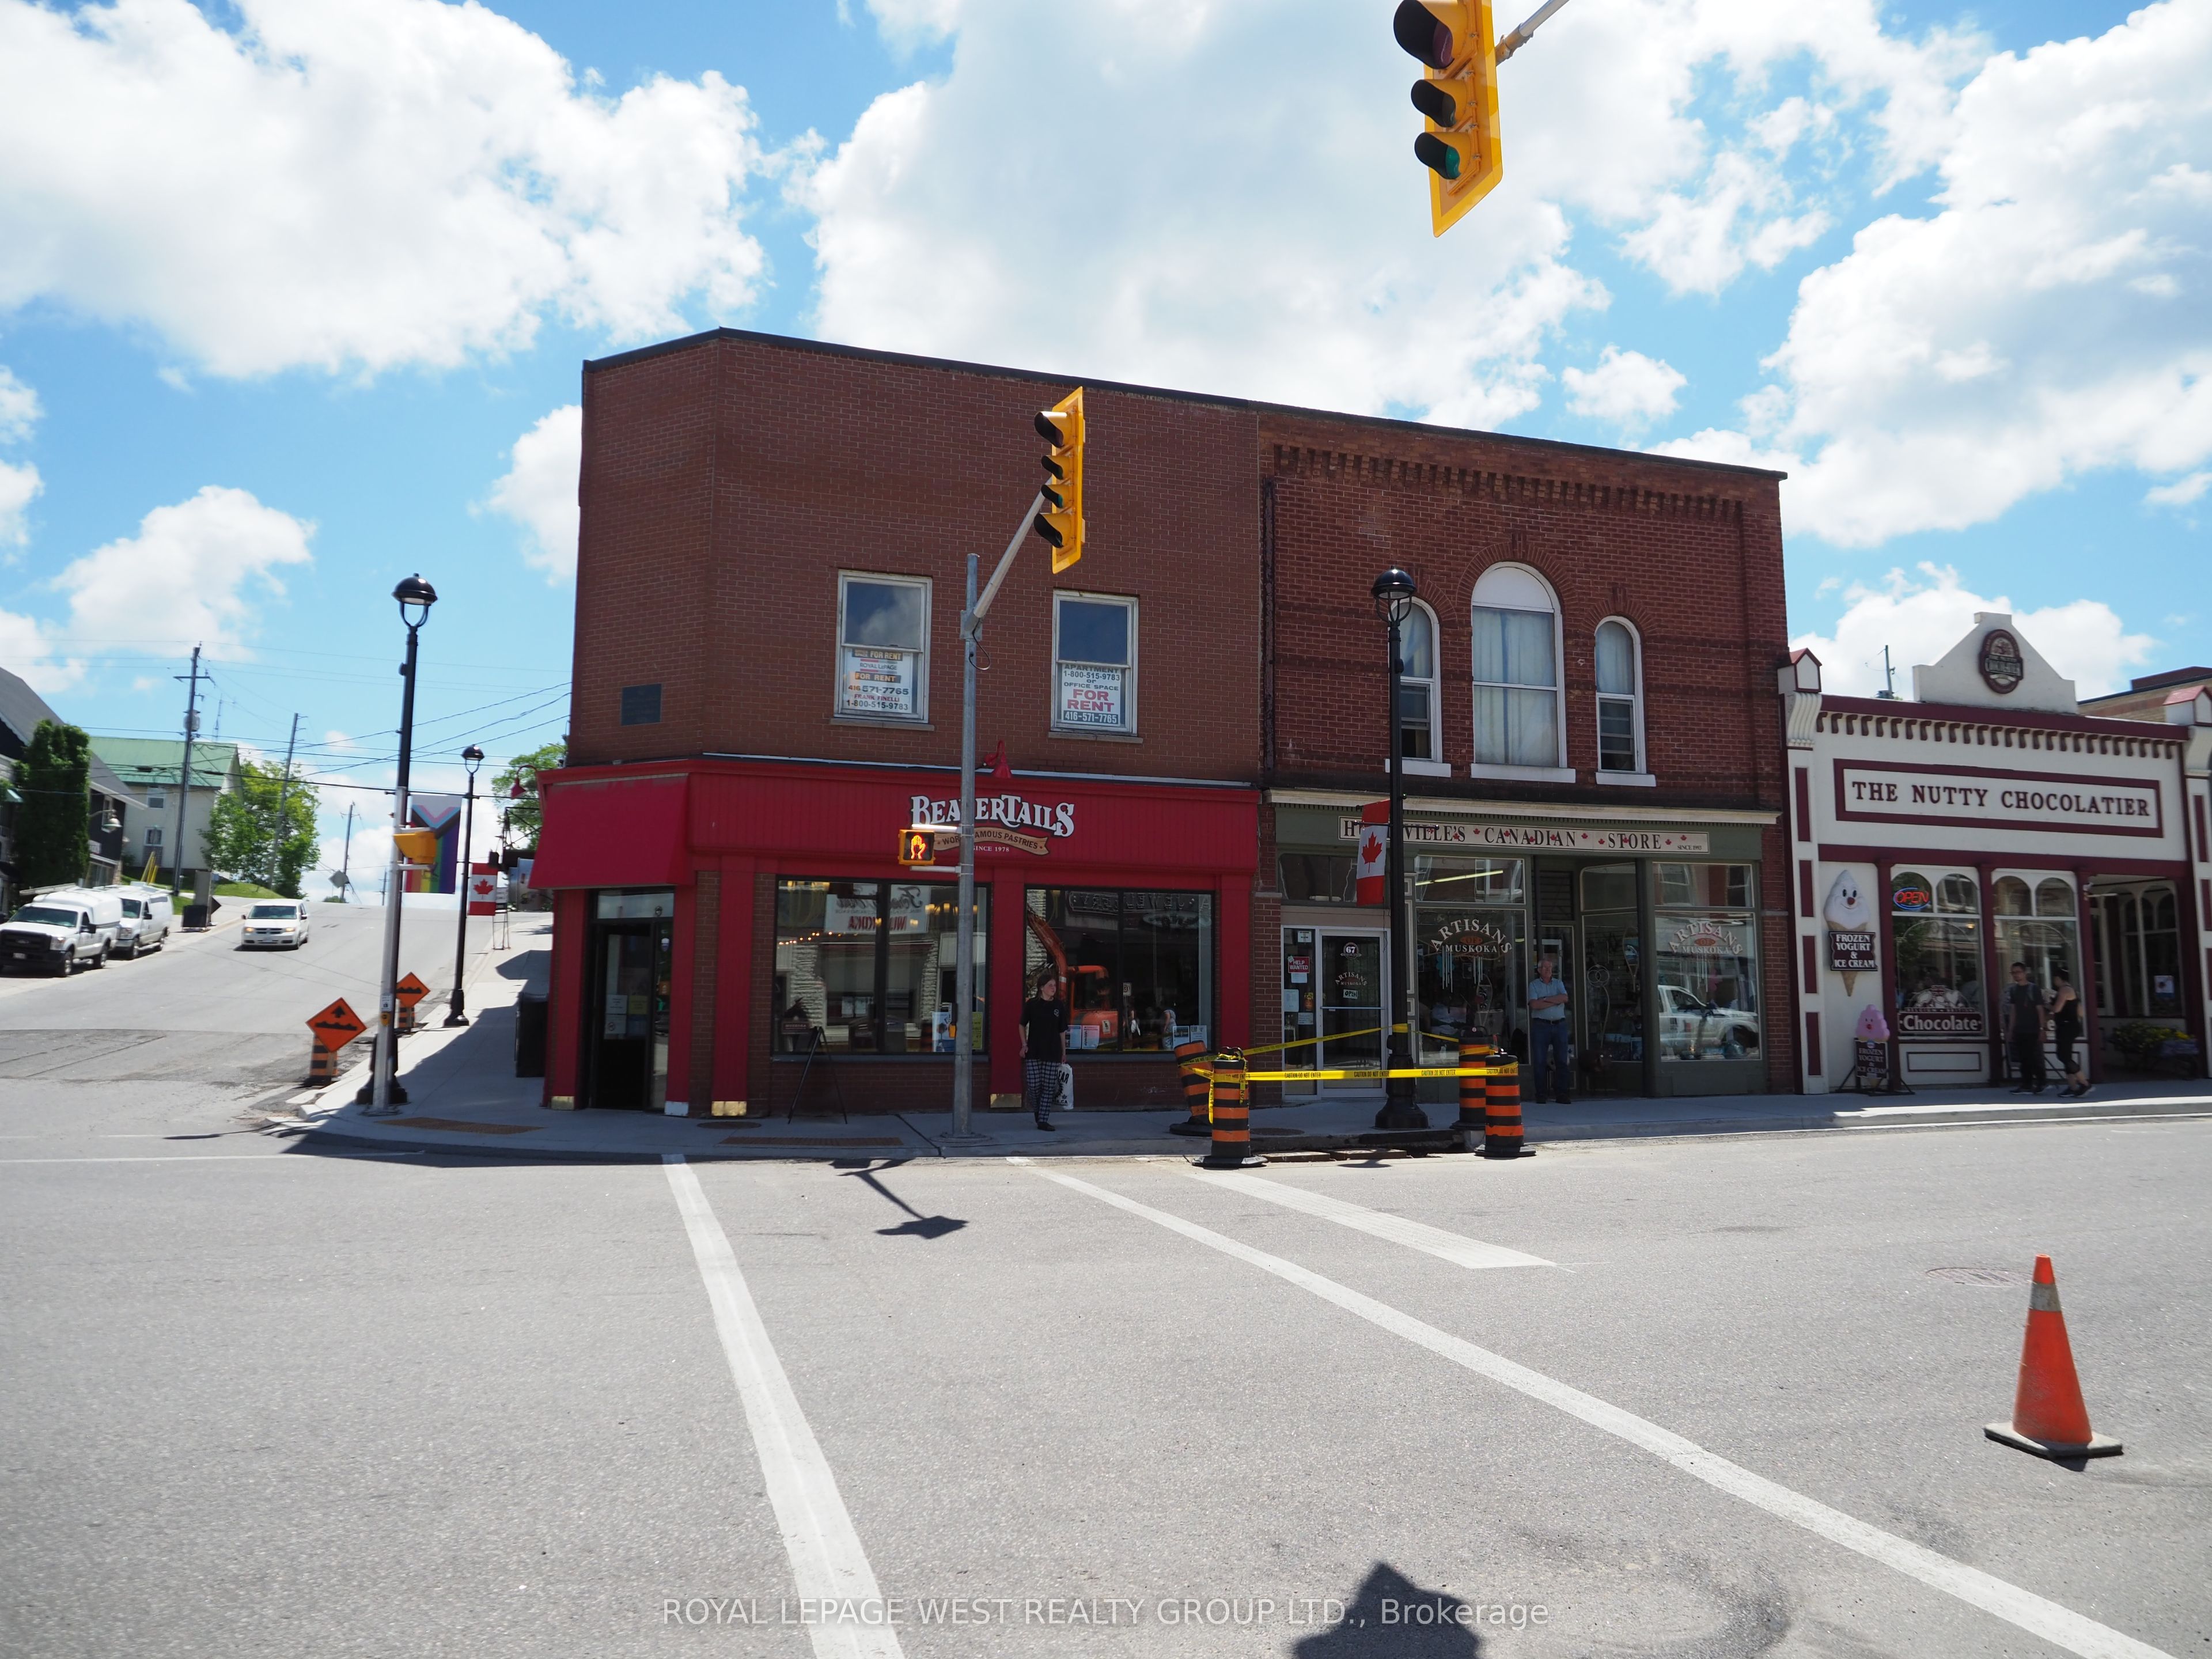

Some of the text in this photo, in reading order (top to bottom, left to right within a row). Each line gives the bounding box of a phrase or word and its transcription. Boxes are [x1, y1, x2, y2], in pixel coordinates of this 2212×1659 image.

[885, 652, 902, 660] RENT
[1064, 664, 1119, 673] APARTMENT
[1063, 671, 1120, 681] 1-800-515-9783
[862, 685, 909, 695] 571-7765
[1073, 688, 1109, 701] FOR
[846, 699, 908, 710] 1-800-515-9783
[1067, 699, 1115, 712] RENT
[1065, 711, 1117, 724] 416-571-7765
[1852, 781, 2150, 816] THE NUTTY CHOCOLATIER
[911, 794, 1075, 837] BEAERTAILS
[942, 831, 1038, 849] WOR AMOUS PASTRIES
[1343, 820, 1661, 849] HVILLE'S CANADIAN STORE
[1895, 891, 1929, 903] OPEN
[1431, 919, 1513, 953] ARTISANS
[1668, 921, 1743, 955] ARTISANS
[1835, 934, 1870, 942] FROZEN
[1445, 944, 1498, 953] MUSKOKA
[1682, 946, 1730, 954] MUSKOKA
[1835, 942, 1871, 950] YOGURT
[1850, 951, 1858, 959] &
[1834, 959, 1874, 968] ICE CREAM
[1335, 972, 1368, 986] ARTISANS
[1903, 1014, 1978, 1031] Chocolate
